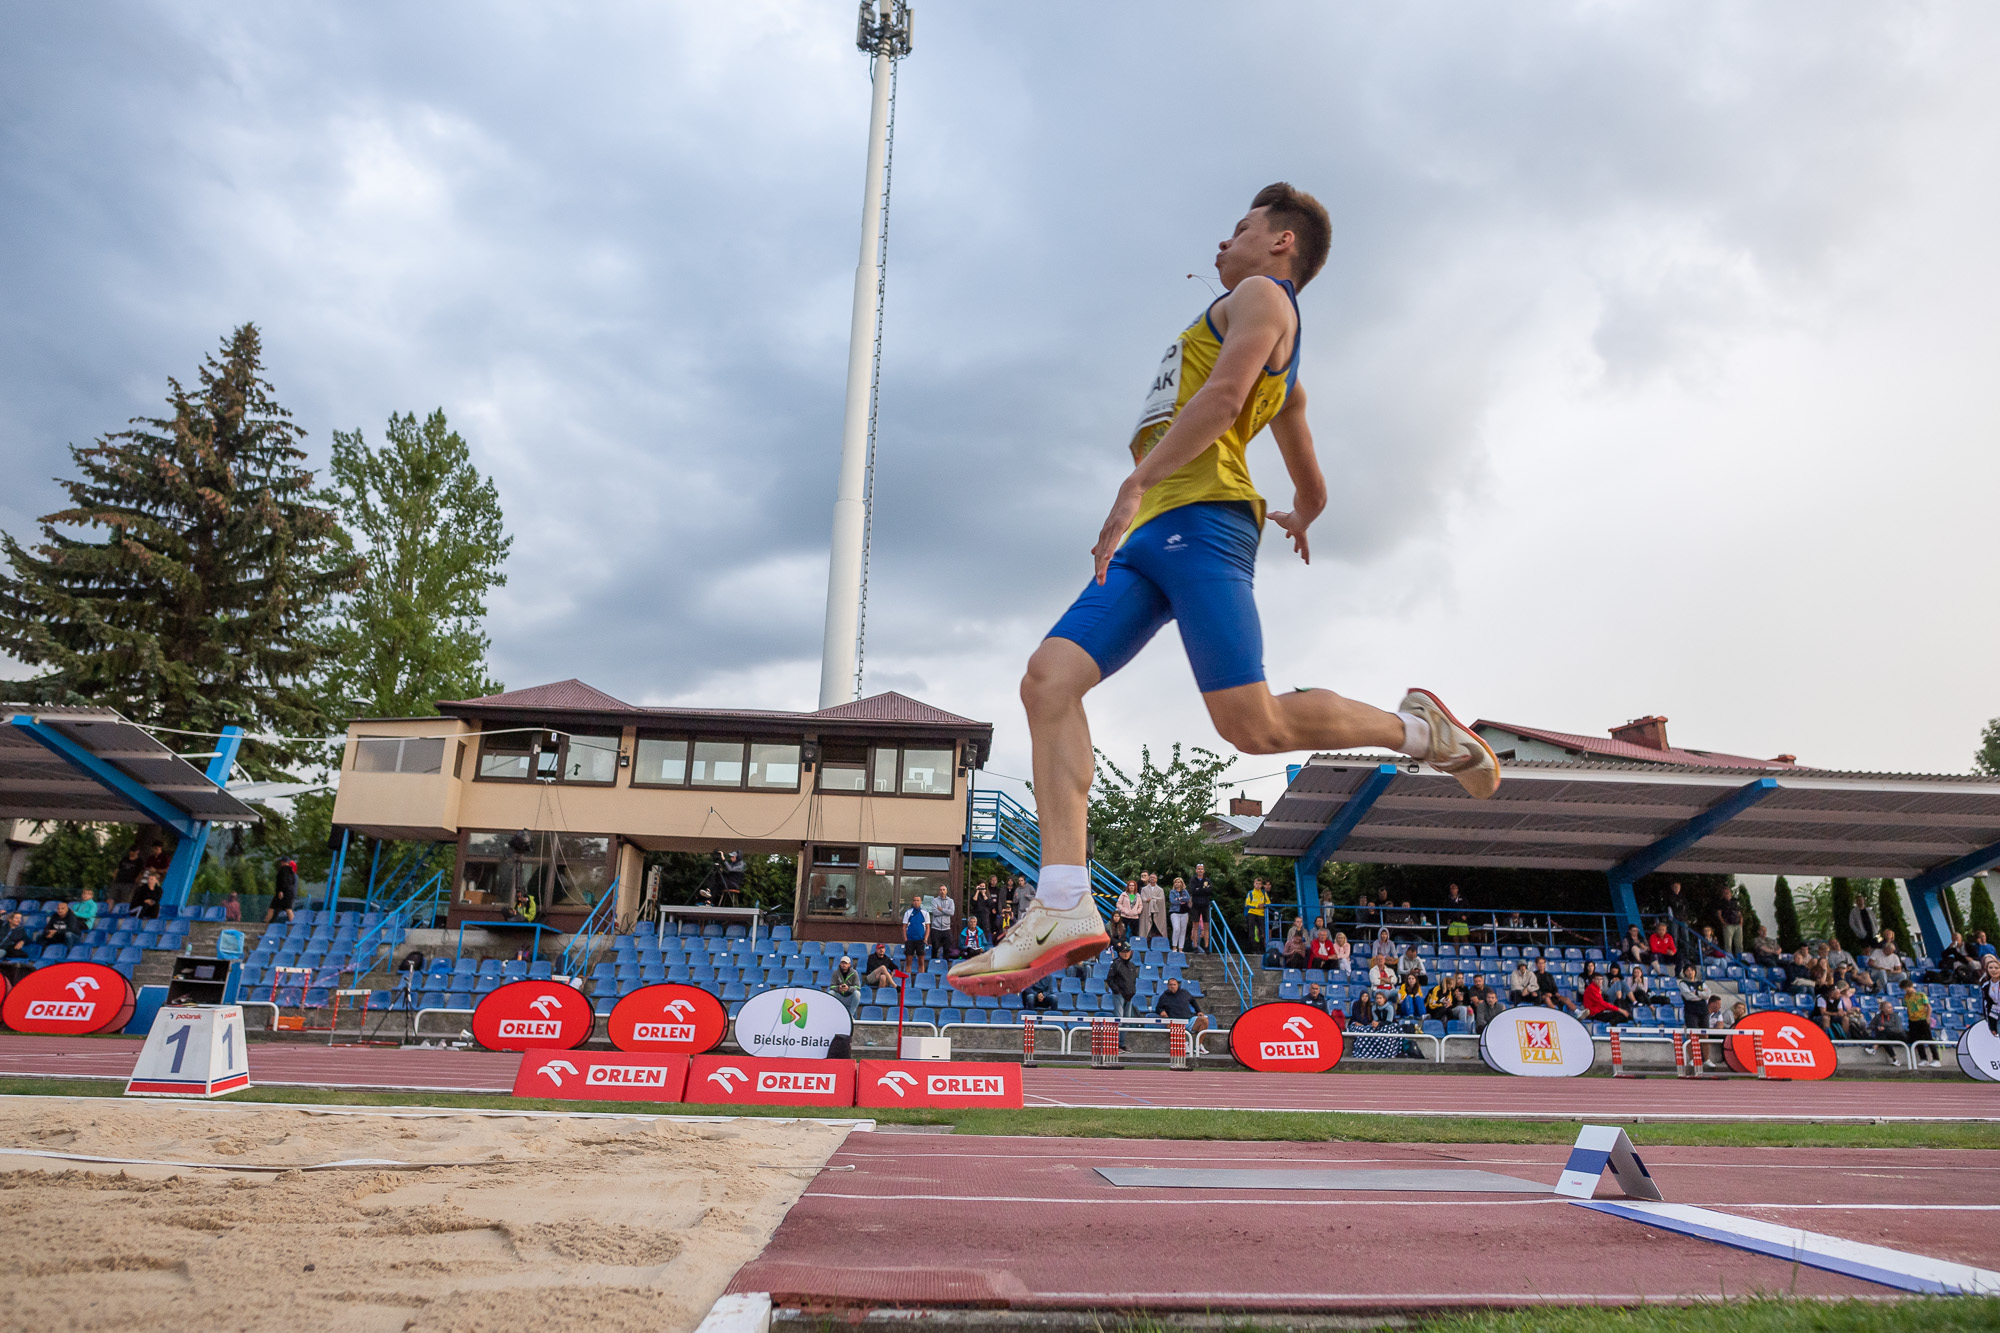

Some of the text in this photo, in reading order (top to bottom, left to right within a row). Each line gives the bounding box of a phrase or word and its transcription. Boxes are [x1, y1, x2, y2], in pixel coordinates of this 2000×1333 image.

[31, 1003, 90, 1018] ORLEN
[503, 1022, 557, 1036] ORLEN
[637, 1026, 691, 1039] ORLEN
[222, 1023, 233, 1070] 1
[753, 1034, 830, 1047] Bielsko-Biała
[166, 1025, 191, 1073] 1
[1264, 1043, 1315, 1057] ORLEN
[1524, 1049, 1560, 1062] PZLA
[1763, 1051, 1811, 1064] ORLEN
[592, 1068, 662, 1084] ORLEN
[762, 1074, 831, 1091] ORLEN
[931, 1078, 999, 1093] ORLEN
